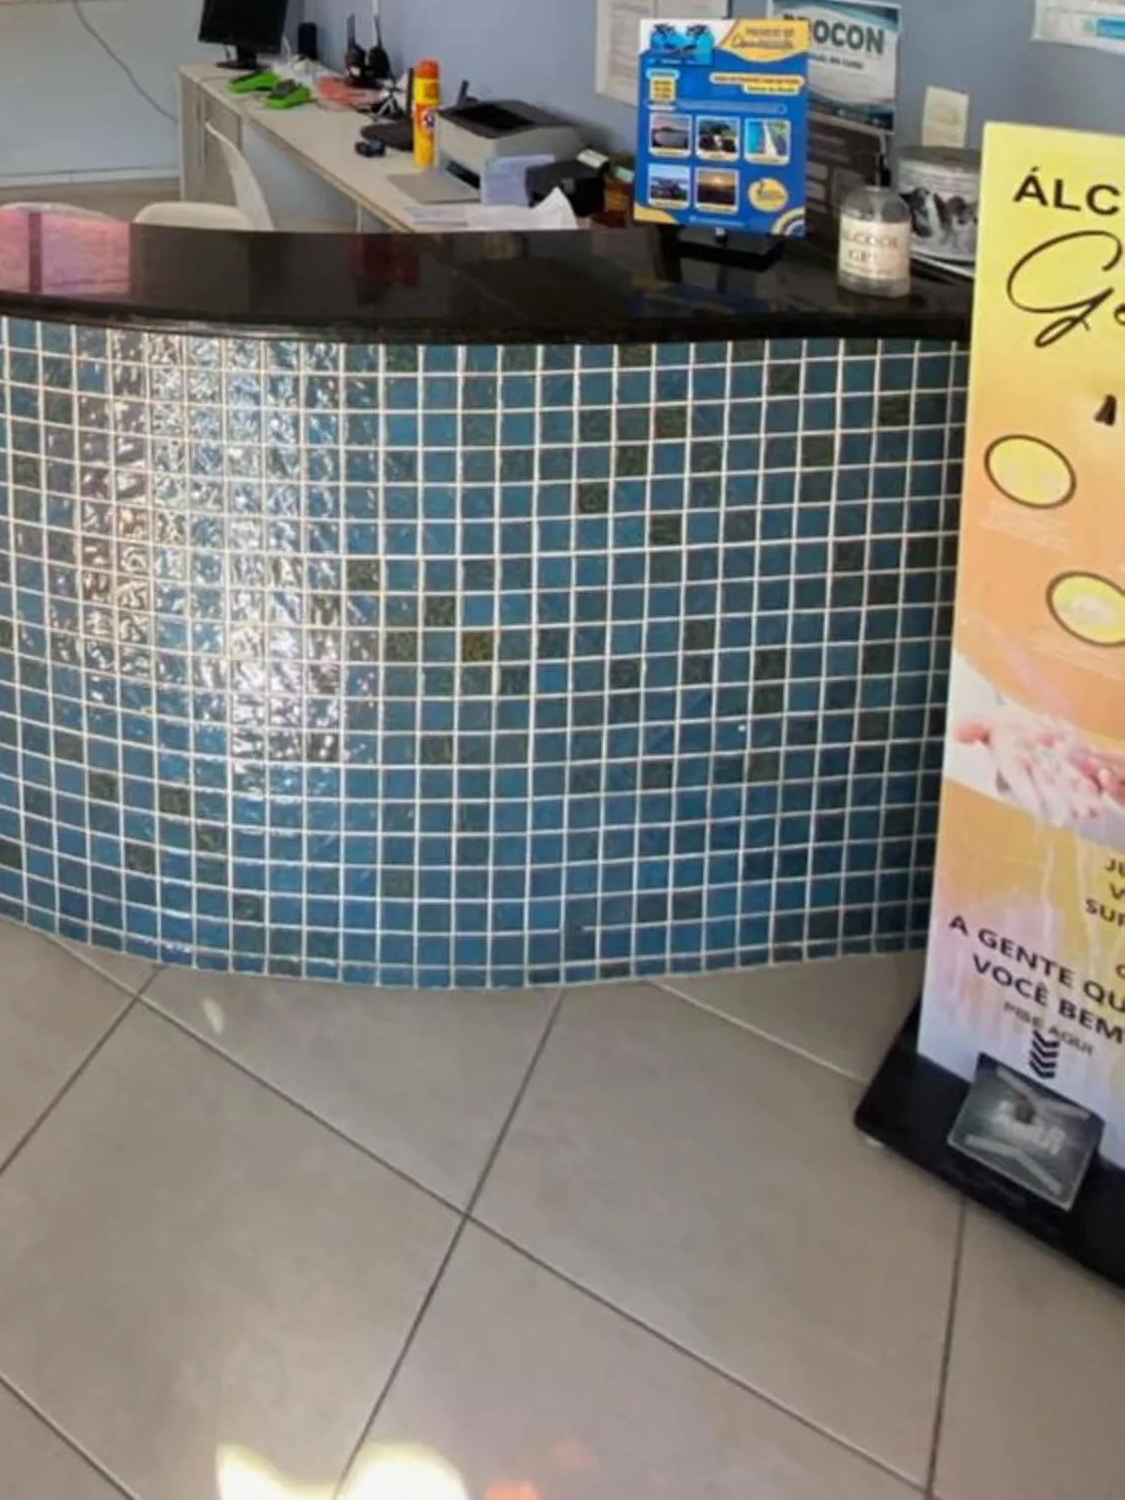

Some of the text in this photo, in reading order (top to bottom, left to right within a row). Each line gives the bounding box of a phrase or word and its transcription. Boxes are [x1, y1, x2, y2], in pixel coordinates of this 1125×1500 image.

[783, 14, 884, 56] OCON
[1013, 166, 1121, 216] ÁLC
[948, 915, 968, 936] A
[978, 928, 1075, 989] GENTE
[973, 953, 1124, 1045] VOCÊ BEM
